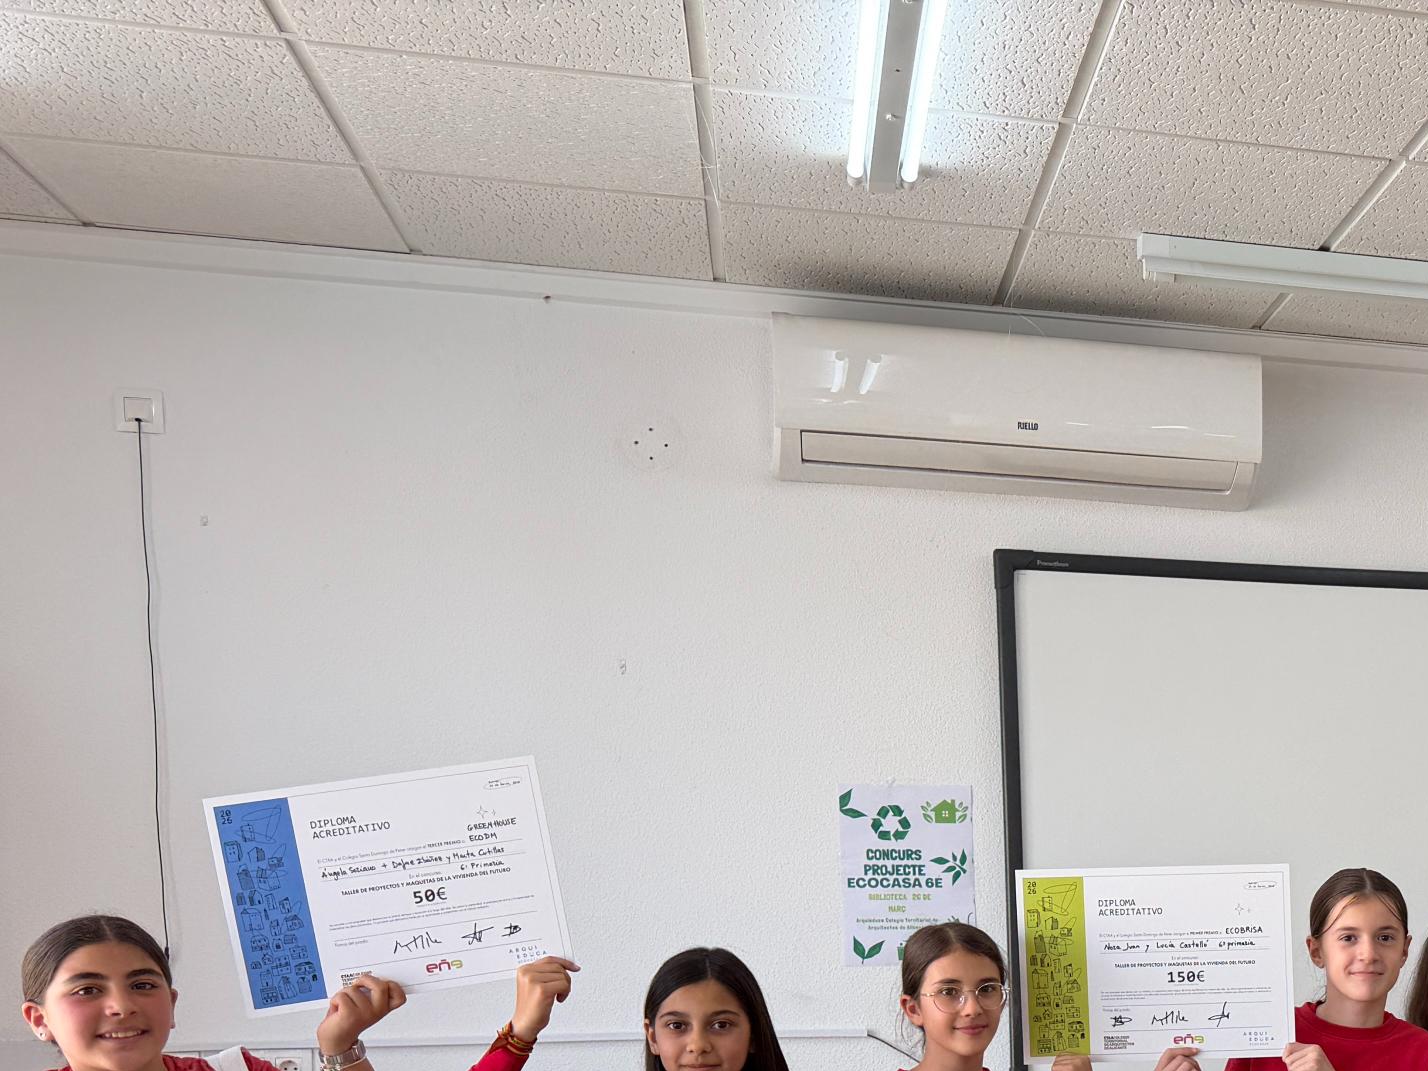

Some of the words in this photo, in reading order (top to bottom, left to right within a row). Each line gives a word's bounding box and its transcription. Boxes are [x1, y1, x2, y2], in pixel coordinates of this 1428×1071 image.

[310, 816, 356, 829] DIPLOMA
[312, 822, 390, 840] ACREDITATIVO
[866, 849, 922, 860] CONCURS
[864, 864, 926, 876] PROJECTE
[369, 883, 400, 892] PROYECTOS
[406, 876, 436, 887] MAQUETAS
[452, 871, 478, 880] VIVIENDA
[489, 867, 511, 875] FUTURO
[848, 878, 922, 888] ECOCASA
[925, 878, 943, 888] 6E
[413, 887, 447, 905] 50€
[1098, 899, 1136, 907] DIPLOMA
[1099, 908, 1163, 916] ACREDITATIVO
[1167, 970, 1205, 984] 150€
